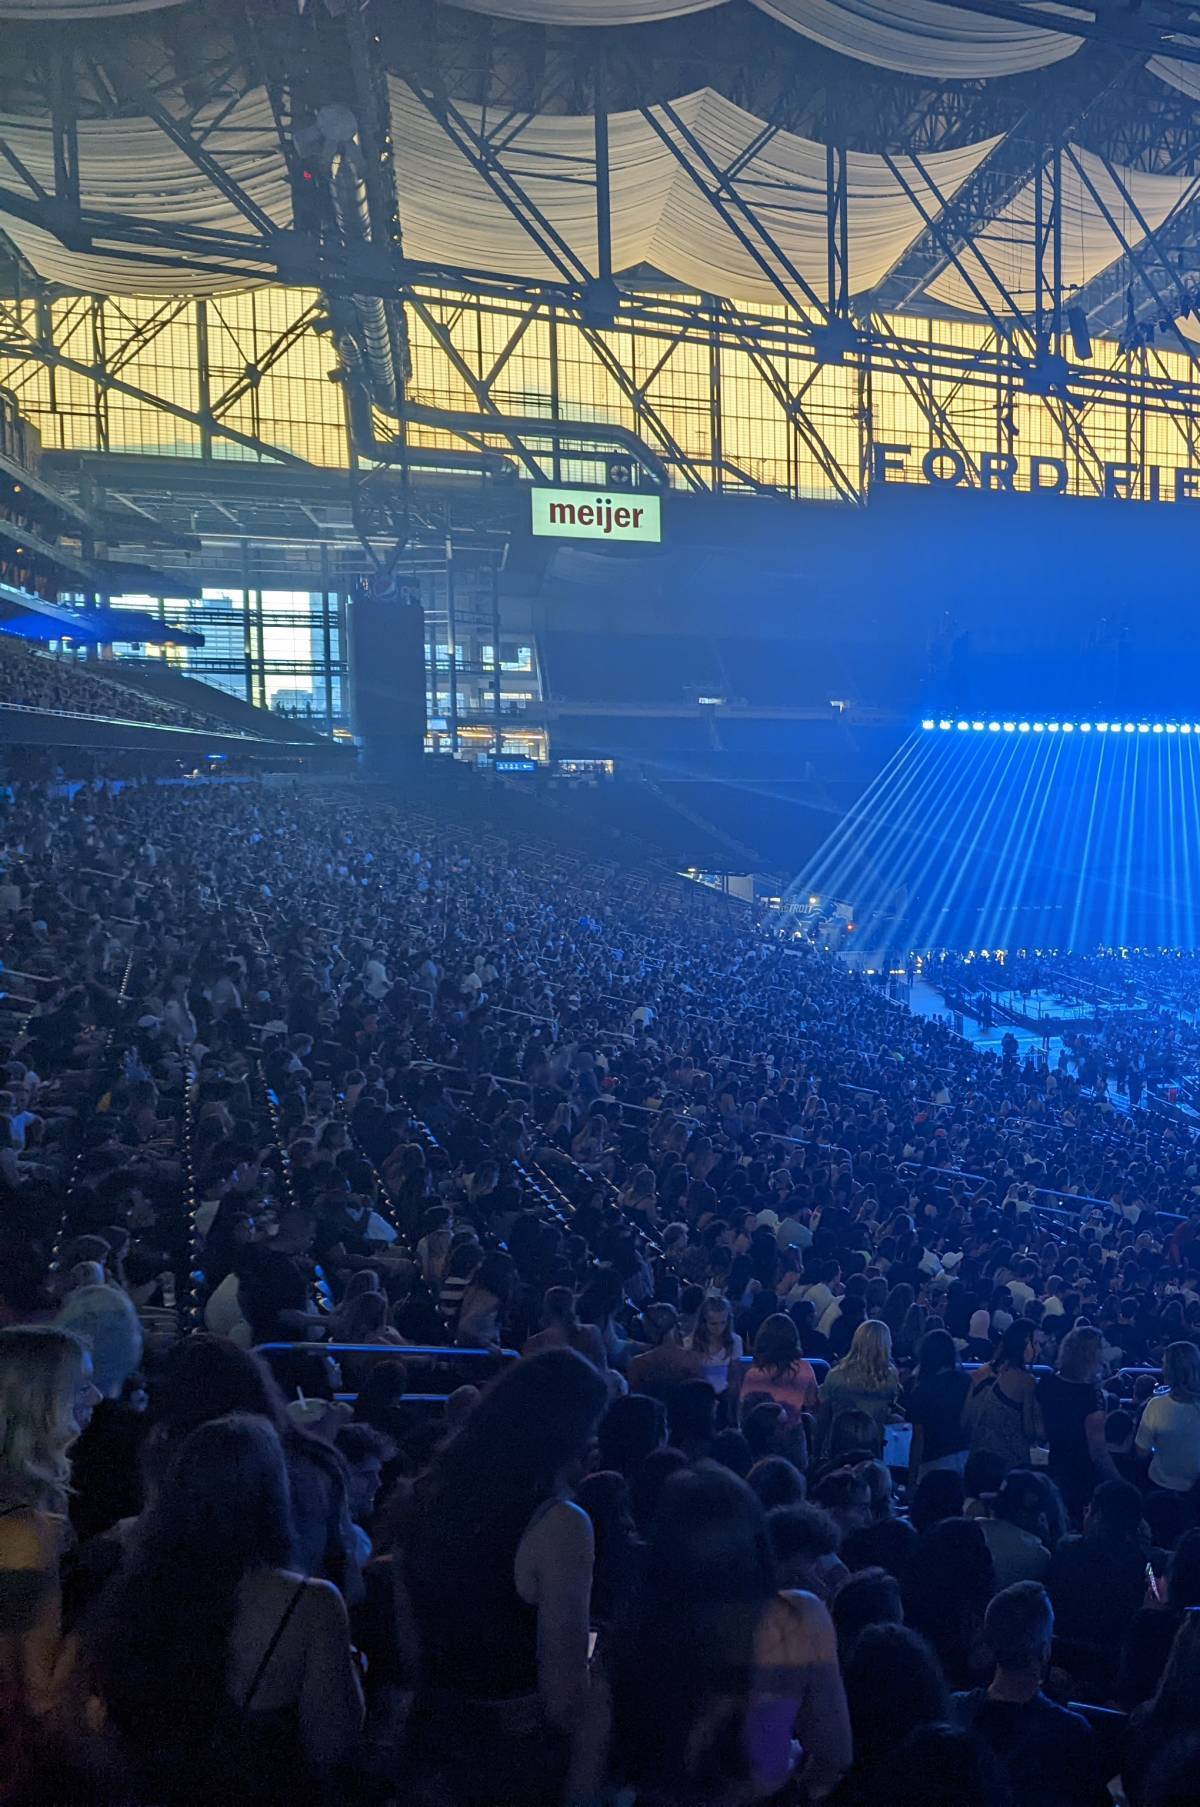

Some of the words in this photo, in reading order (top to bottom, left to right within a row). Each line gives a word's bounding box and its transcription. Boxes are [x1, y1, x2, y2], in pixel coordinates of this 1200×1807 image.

[873, 442, 1068, 493] FORD
[549, 498, 644, 533] meijer
[780, 902, 813, 914] ETROIT
